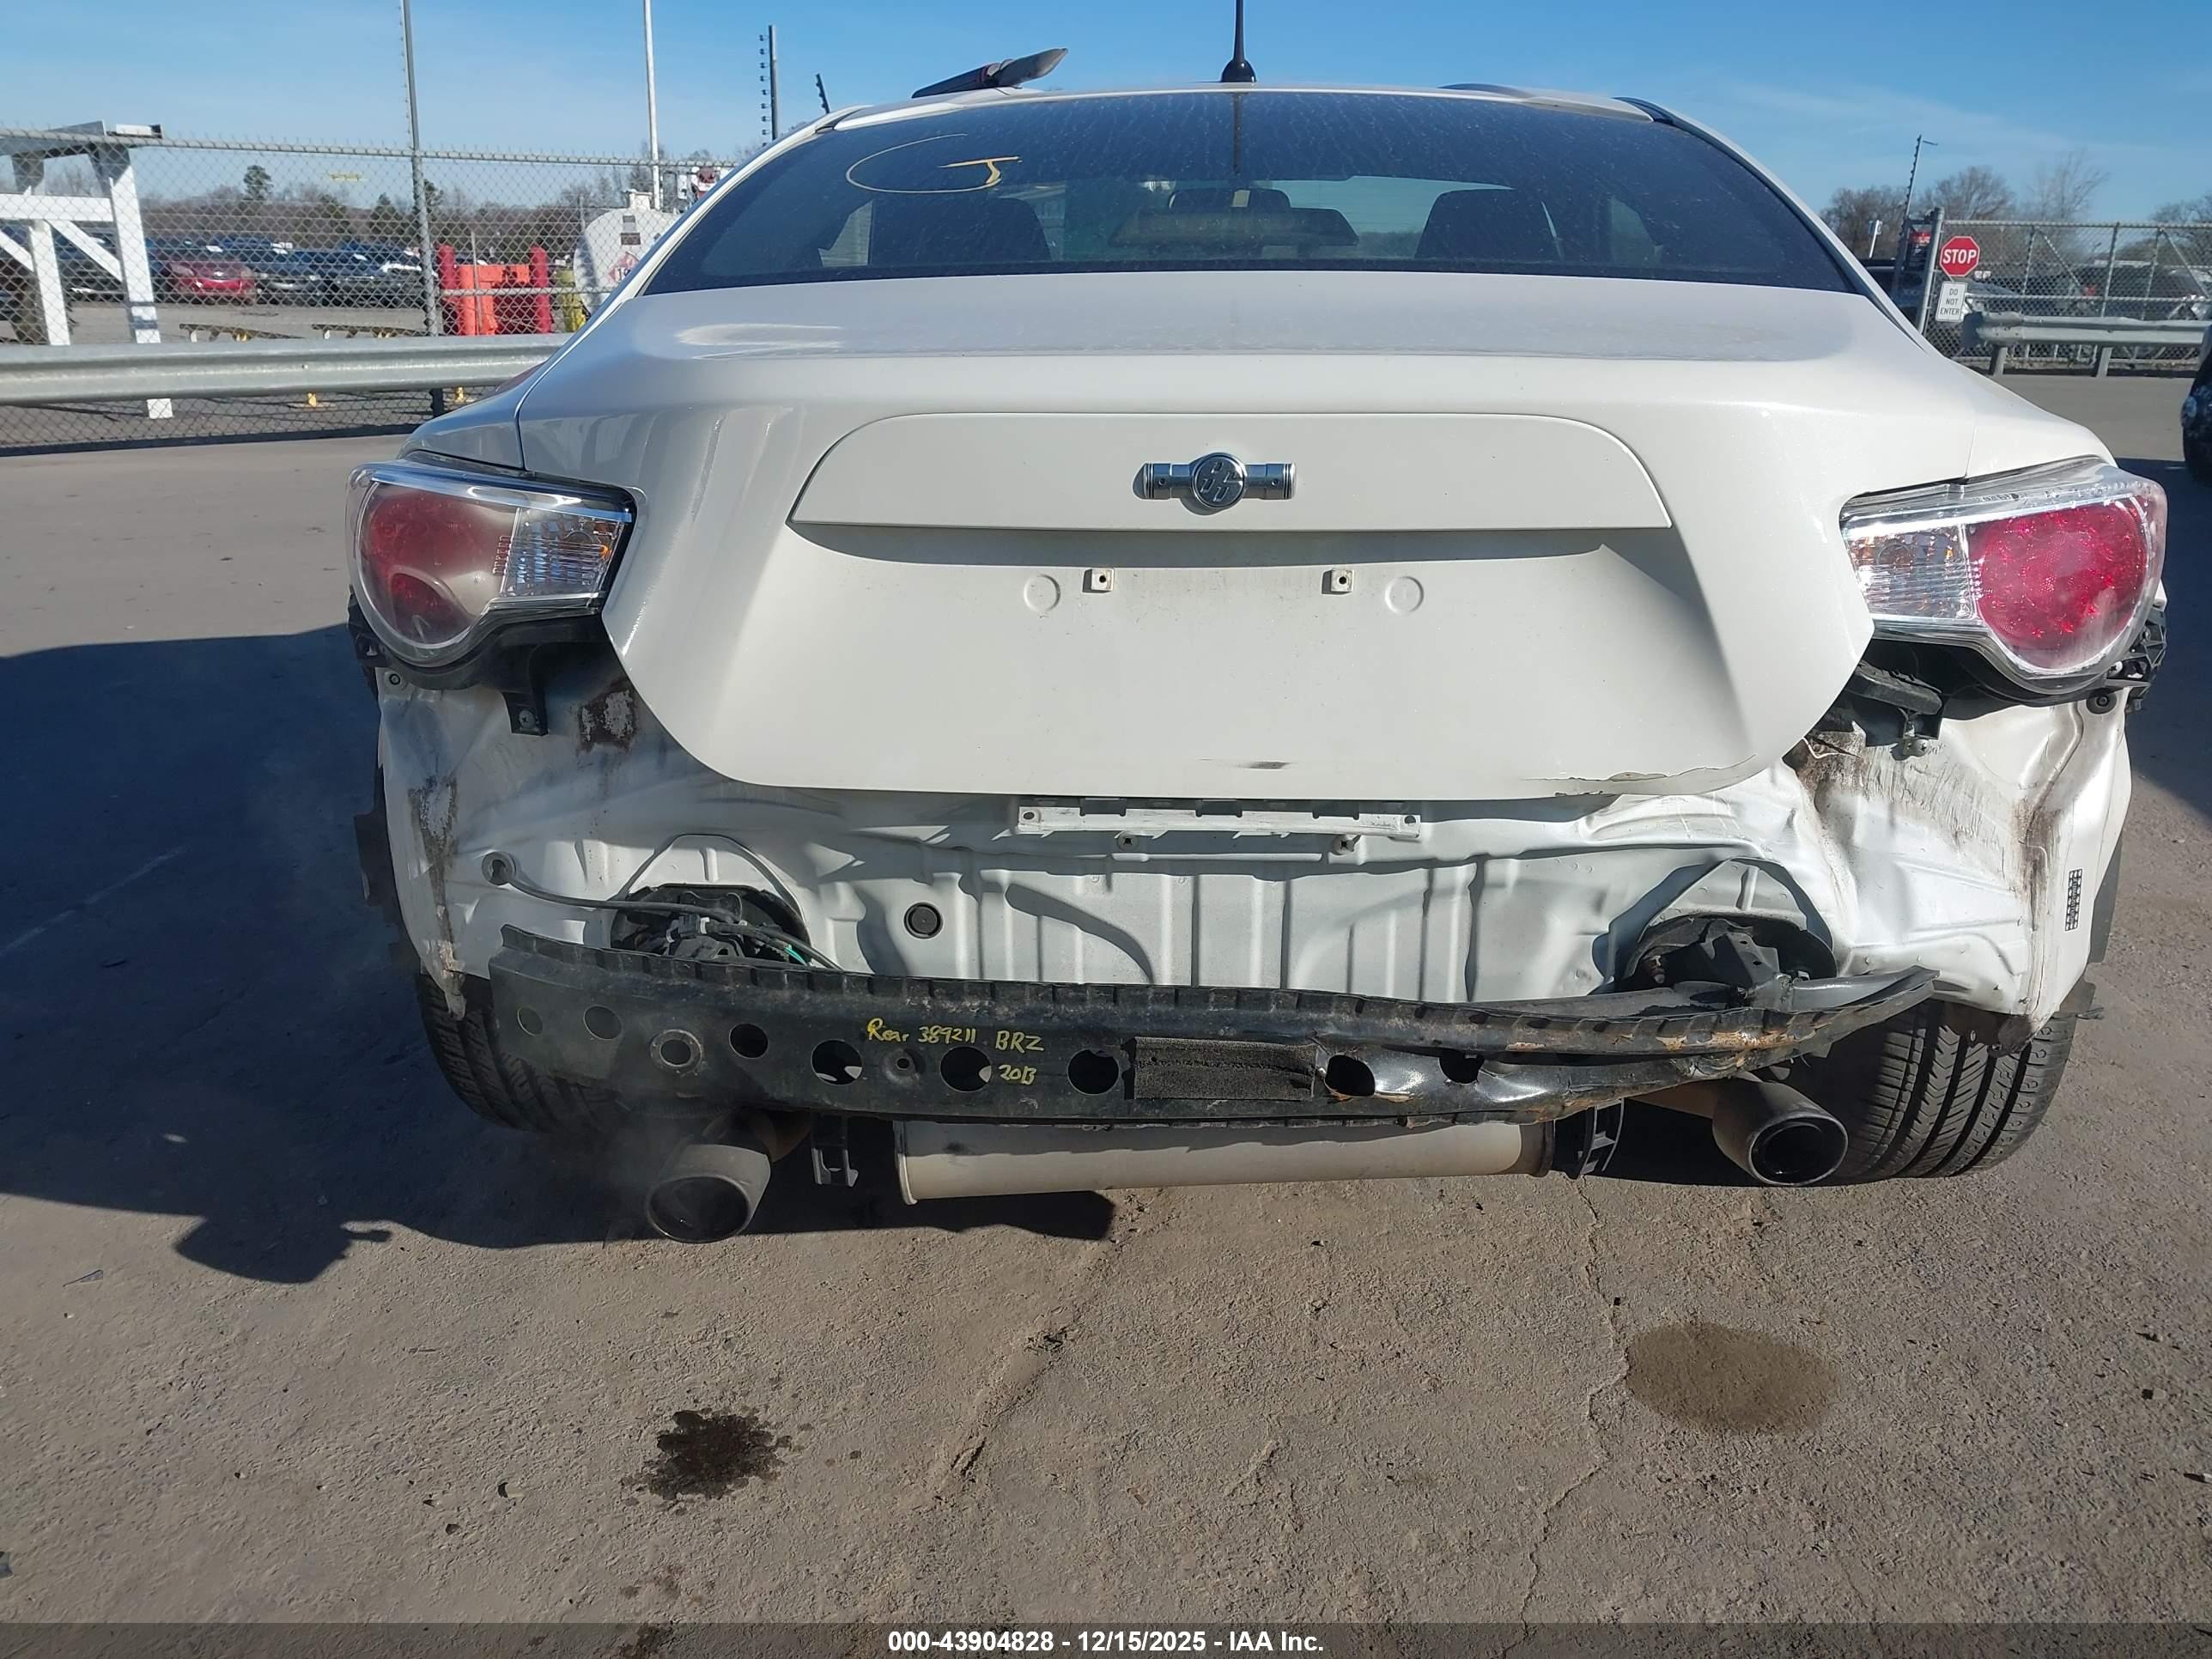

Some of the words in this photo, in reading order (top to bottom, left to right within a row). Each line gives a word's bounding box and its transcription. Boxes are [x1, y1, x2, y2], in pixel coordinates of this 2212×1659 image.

[1942, 249, 1977, 264] STOP
[1949, 288, 1959, 296] DO
[867, 1018, 910, 1042] Rear
[917, 1024, 977, 1044] 389211
[994, 1030, 1045, 1054] BRZ
